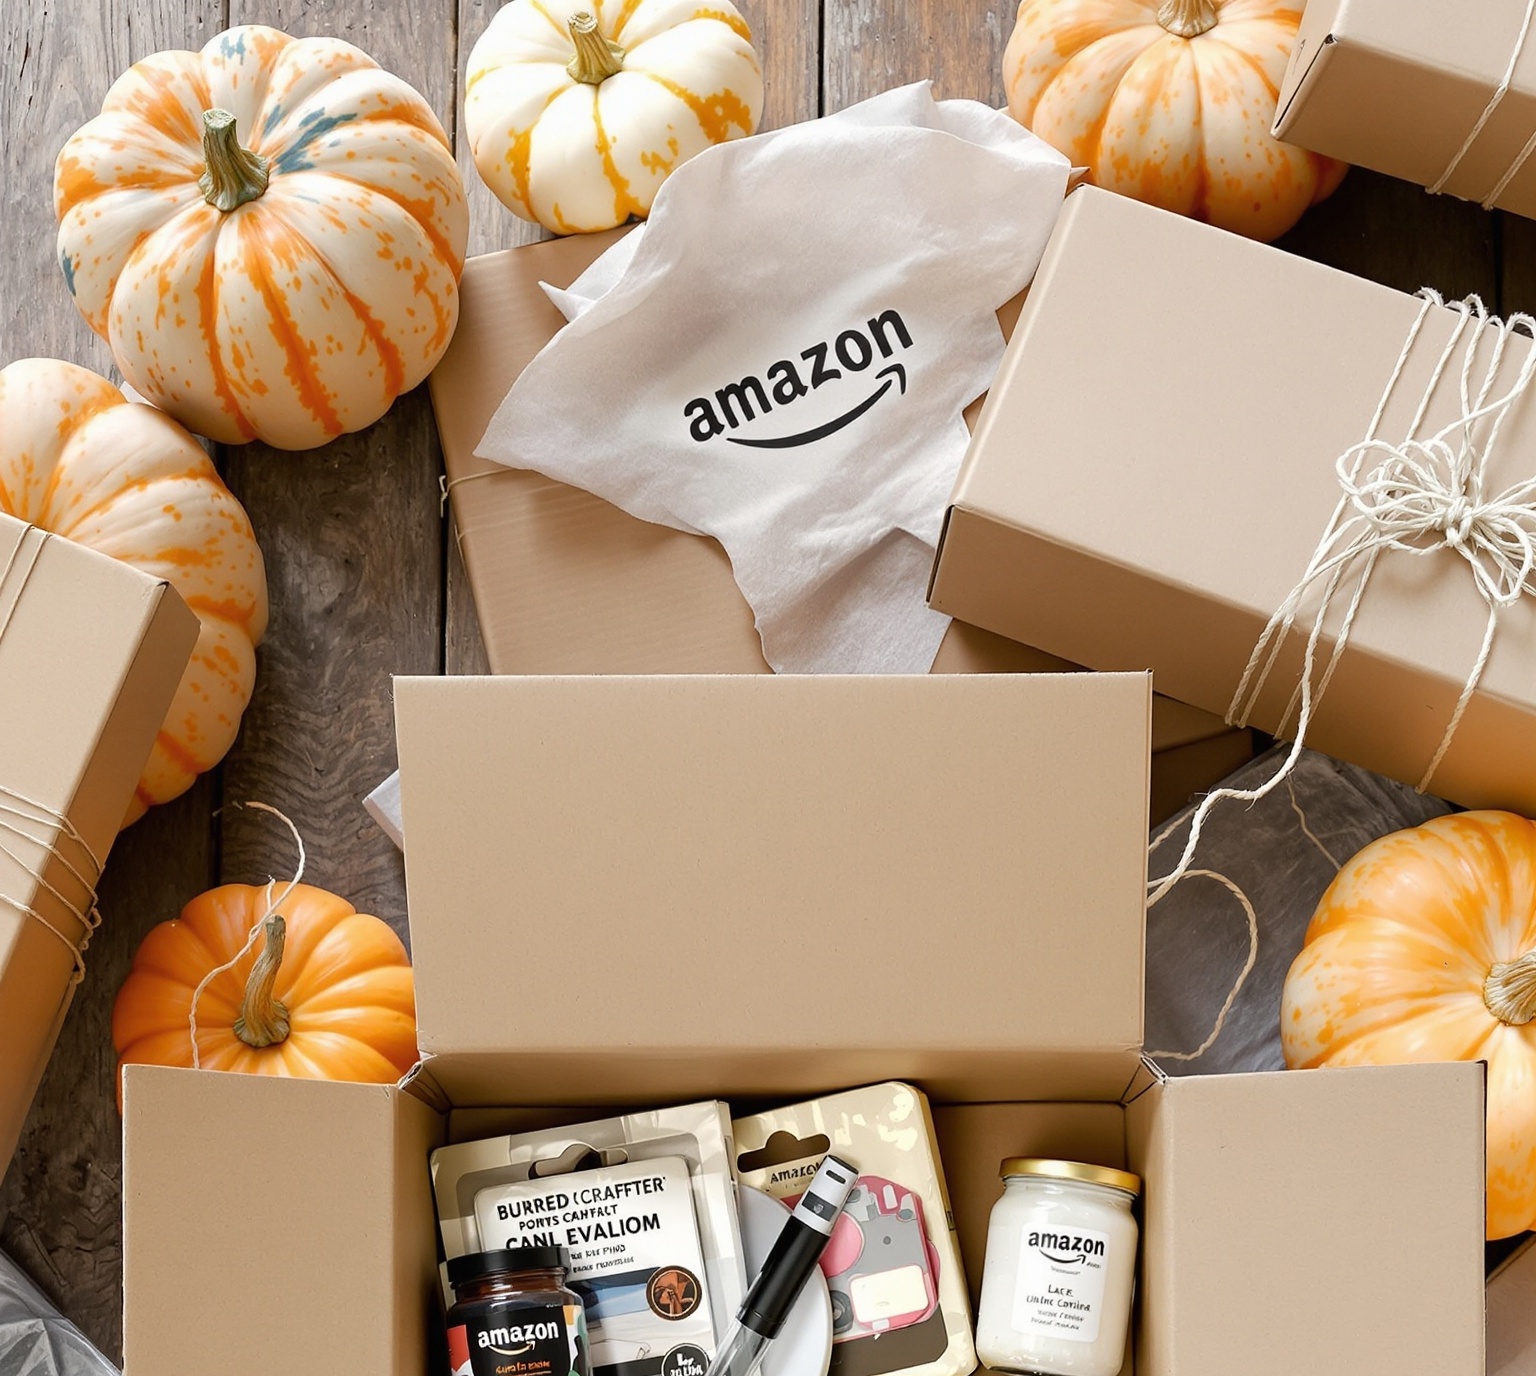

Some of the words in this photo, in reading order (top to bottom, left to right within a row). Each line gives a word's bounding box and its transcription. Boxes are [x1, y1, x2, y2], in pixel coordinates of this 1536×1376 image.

[683, 309, 914, 443] amazon
[496, 1193, 570, 1221] BURRED
[565, 1212, 662, 1246] EVALIOM
[1028, 1231, 1105, 1257] amazon
[477, 1321, 560, 1349] amazon
